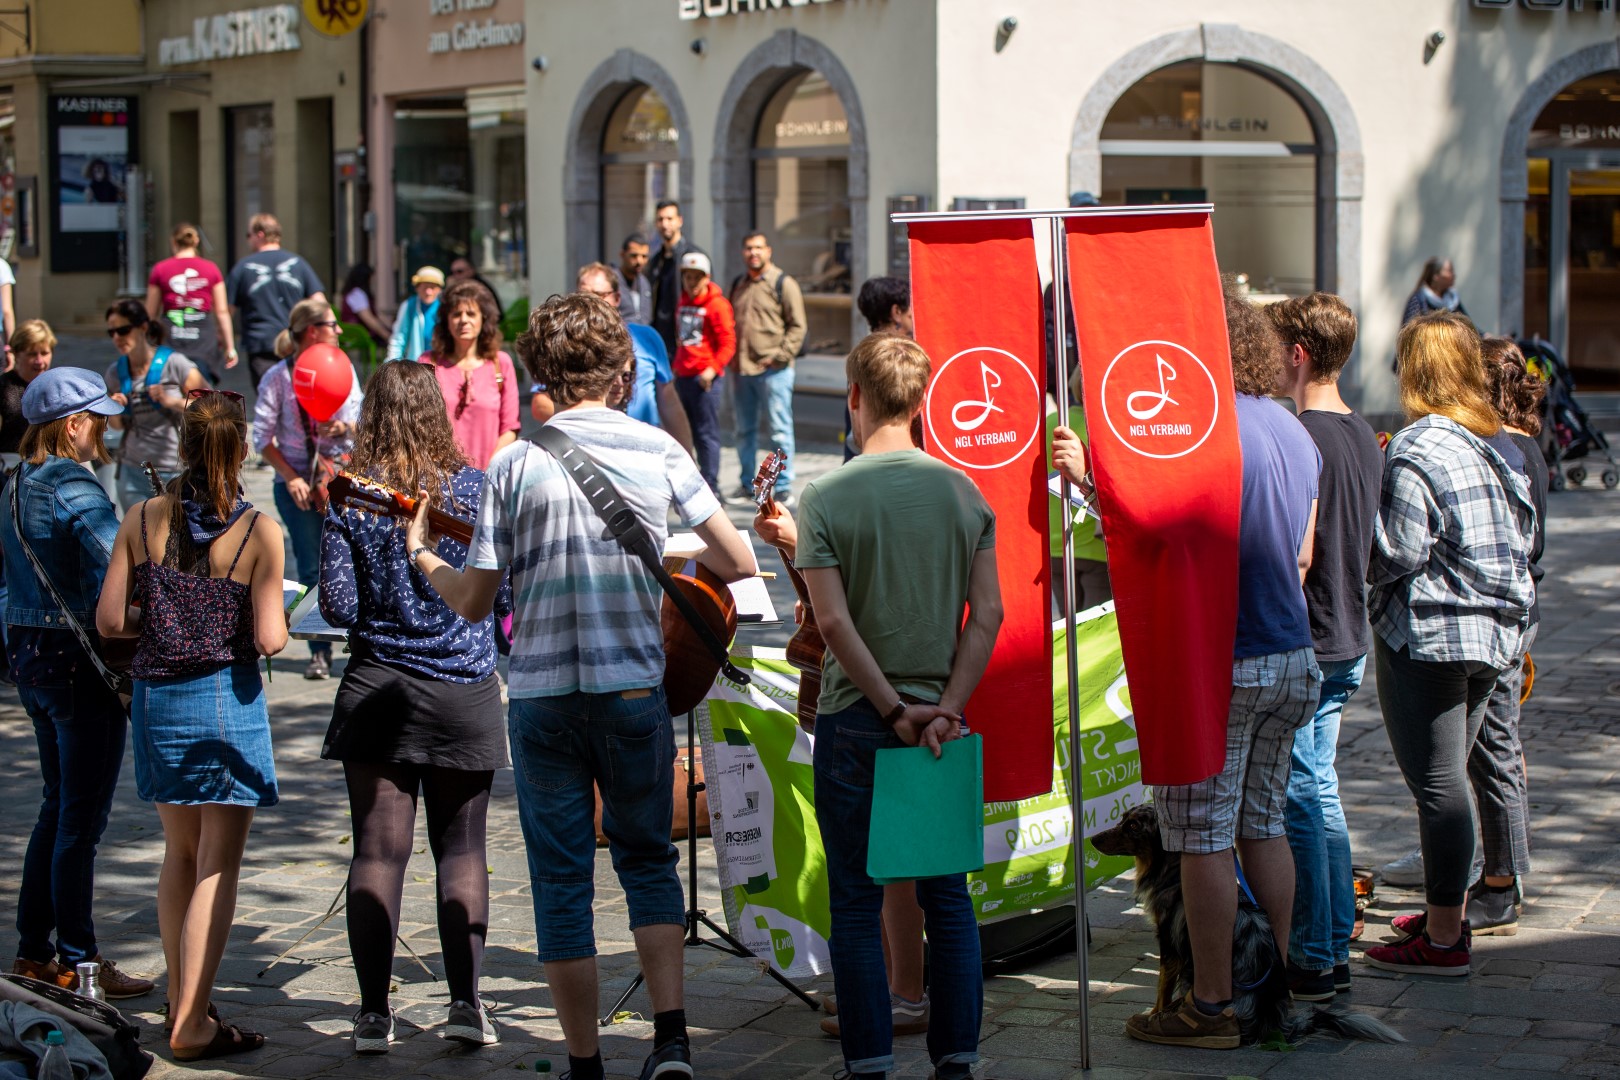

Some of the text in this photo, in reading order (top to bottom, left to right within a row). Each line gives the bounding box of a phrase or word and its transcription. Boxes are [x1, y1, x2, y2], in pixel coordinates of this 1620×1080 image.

[193, 4, 301, 60] KASTNER
[58, 97, 128, 112] KASTNER
[1129, 423, 1192, 436] NGL VERBAND
[955, 430, 1017, 448] NGL VERBAND
